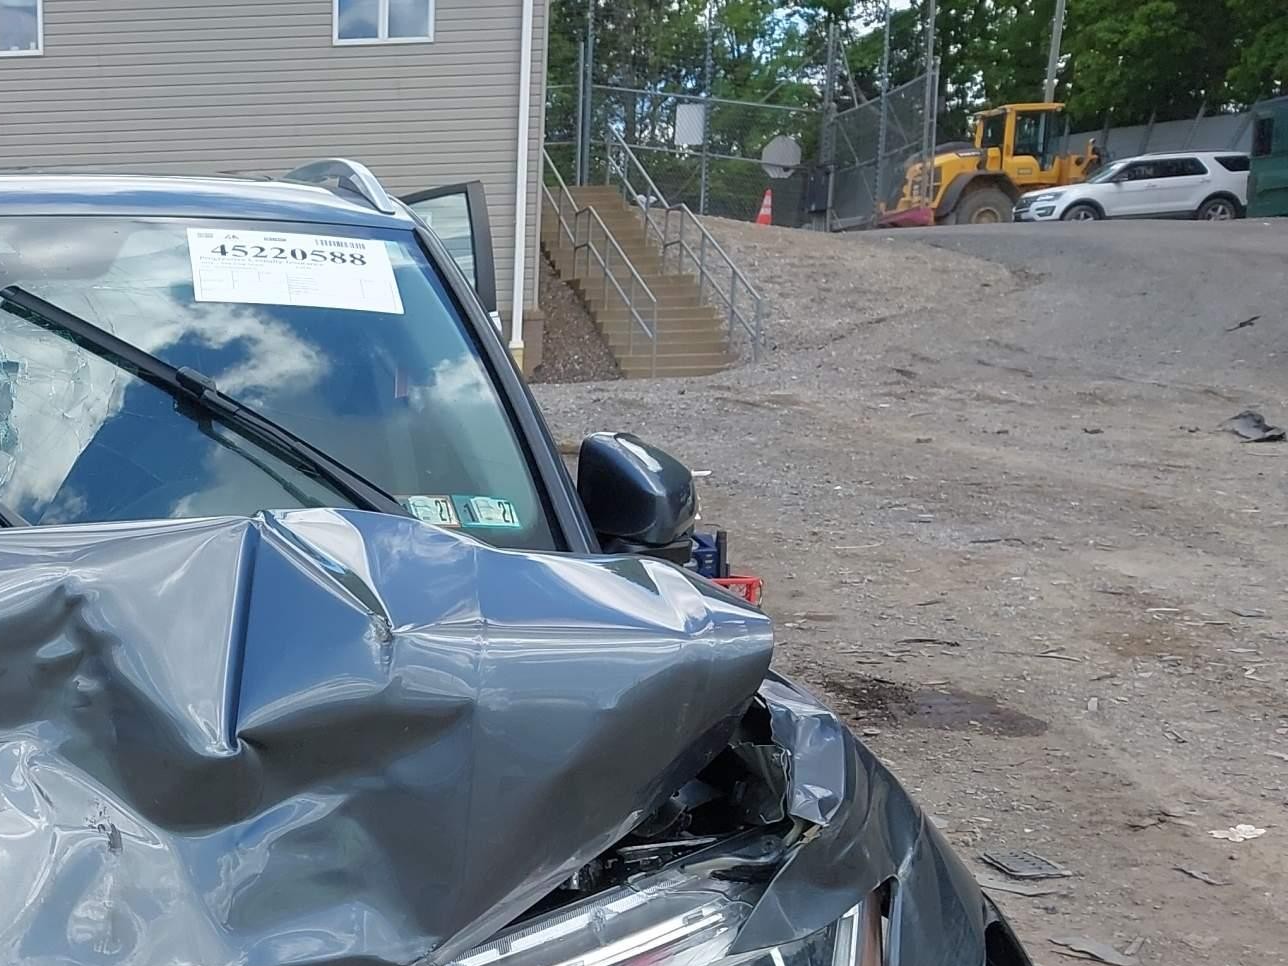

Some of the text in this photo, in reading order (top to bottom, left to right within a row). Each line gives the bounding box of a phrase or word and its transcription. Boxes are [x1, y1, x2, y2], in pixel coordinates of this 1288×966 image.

[211, 243, 367, 266] 45220588
[434, 499, 452, 522] 27
[498, 501, 515, 523] 27
